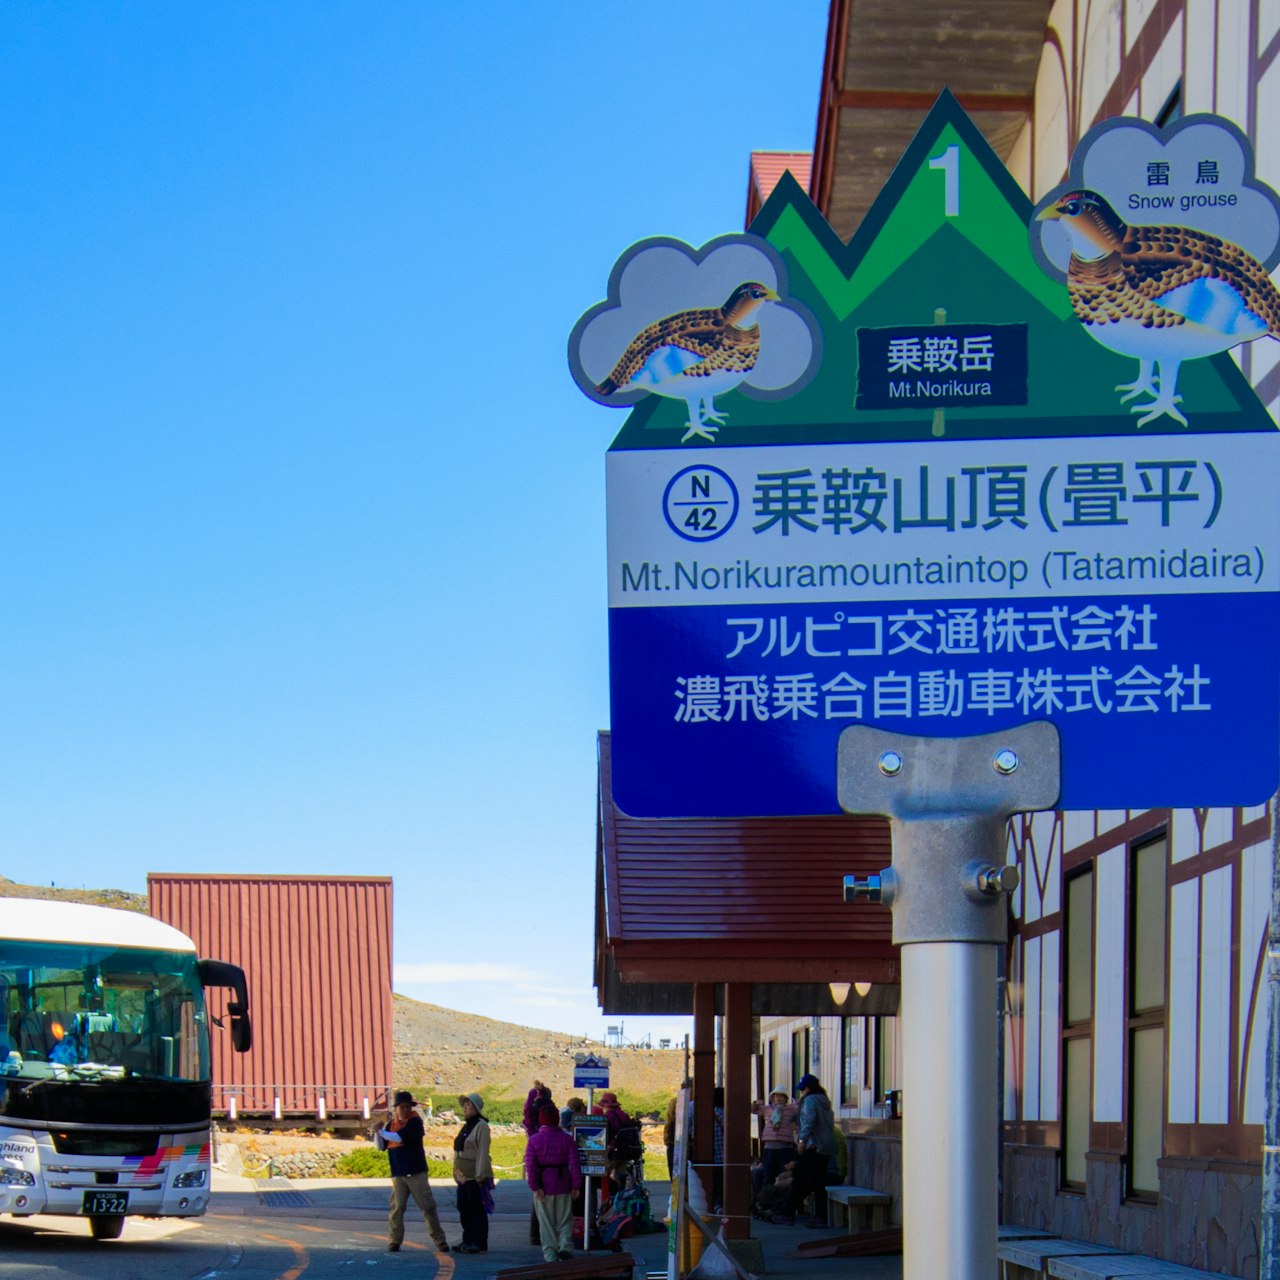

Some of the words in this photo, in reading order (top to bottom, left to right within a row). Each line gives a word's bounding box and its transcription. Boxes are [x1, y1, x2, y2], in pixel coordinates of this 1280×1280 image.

[929, 145, 959, 217] 1
[1146, 158, 1221, 187] 雷鳥
[1127, 192, 1174, 210] Snow
[1179, 190, 1238, 211] grouse
[887, 336, 994, 374] 乗鞍岳
[888, 379, 992, 398] Mt.Norikura
[691, 476, 710, 498] N
[751, 460, 1223, 537] 乗鞍山頂(畳平)
[684, 509, 717, 531] 42
[621, 555, 1029, 592] Mt.Norikuramountaintop
[1041, 547, 1265, 587] (Tatamidaira)
[725, 605, 1158, 658] アルピコ交通株式会社
[674, 663, 1211, 724] 濃飛乗合自動車株式会社
